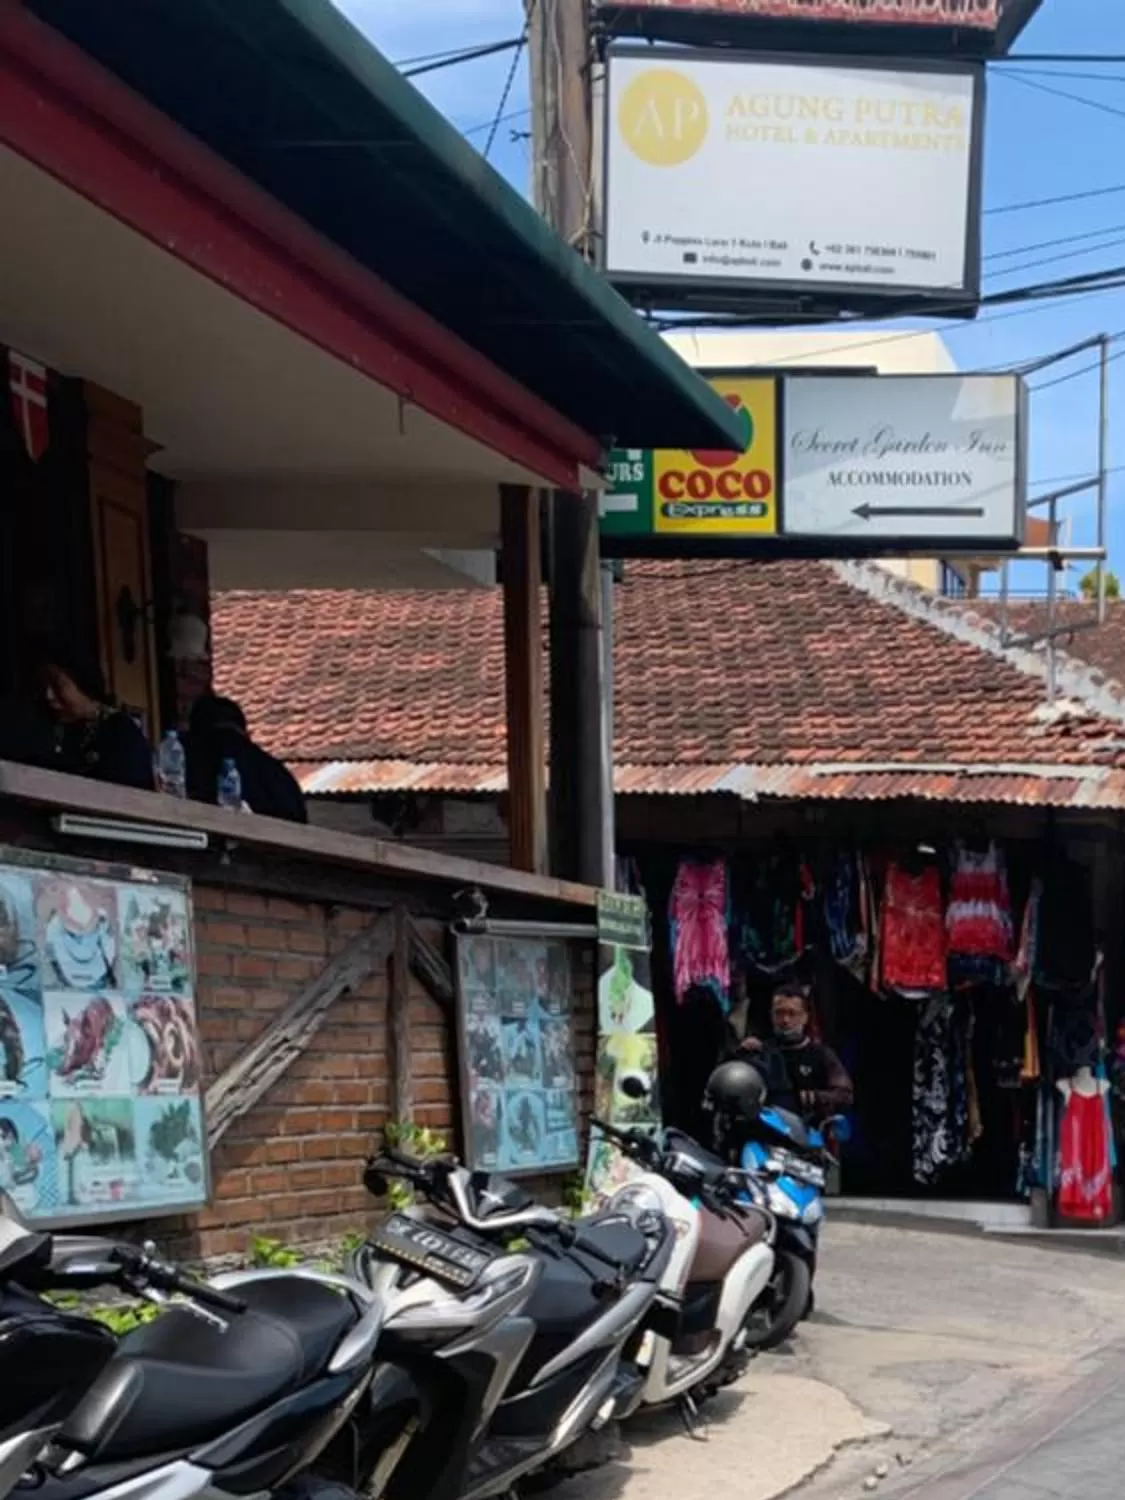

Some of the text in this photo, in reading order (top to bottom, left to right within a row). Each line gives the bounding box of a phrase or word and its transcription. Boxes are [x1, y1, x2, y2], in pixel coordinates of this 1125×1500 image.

[633, 97, 699, 141] AP
[726, 93, 963, 129] AGUNG PUTRA
[725, 122, 799, 144] HOTEL
[861, 424, 949, 458] Garden
[658, 469, 772, 500] COCO
[826, 469, 973, 488] ACCOMMODATION
